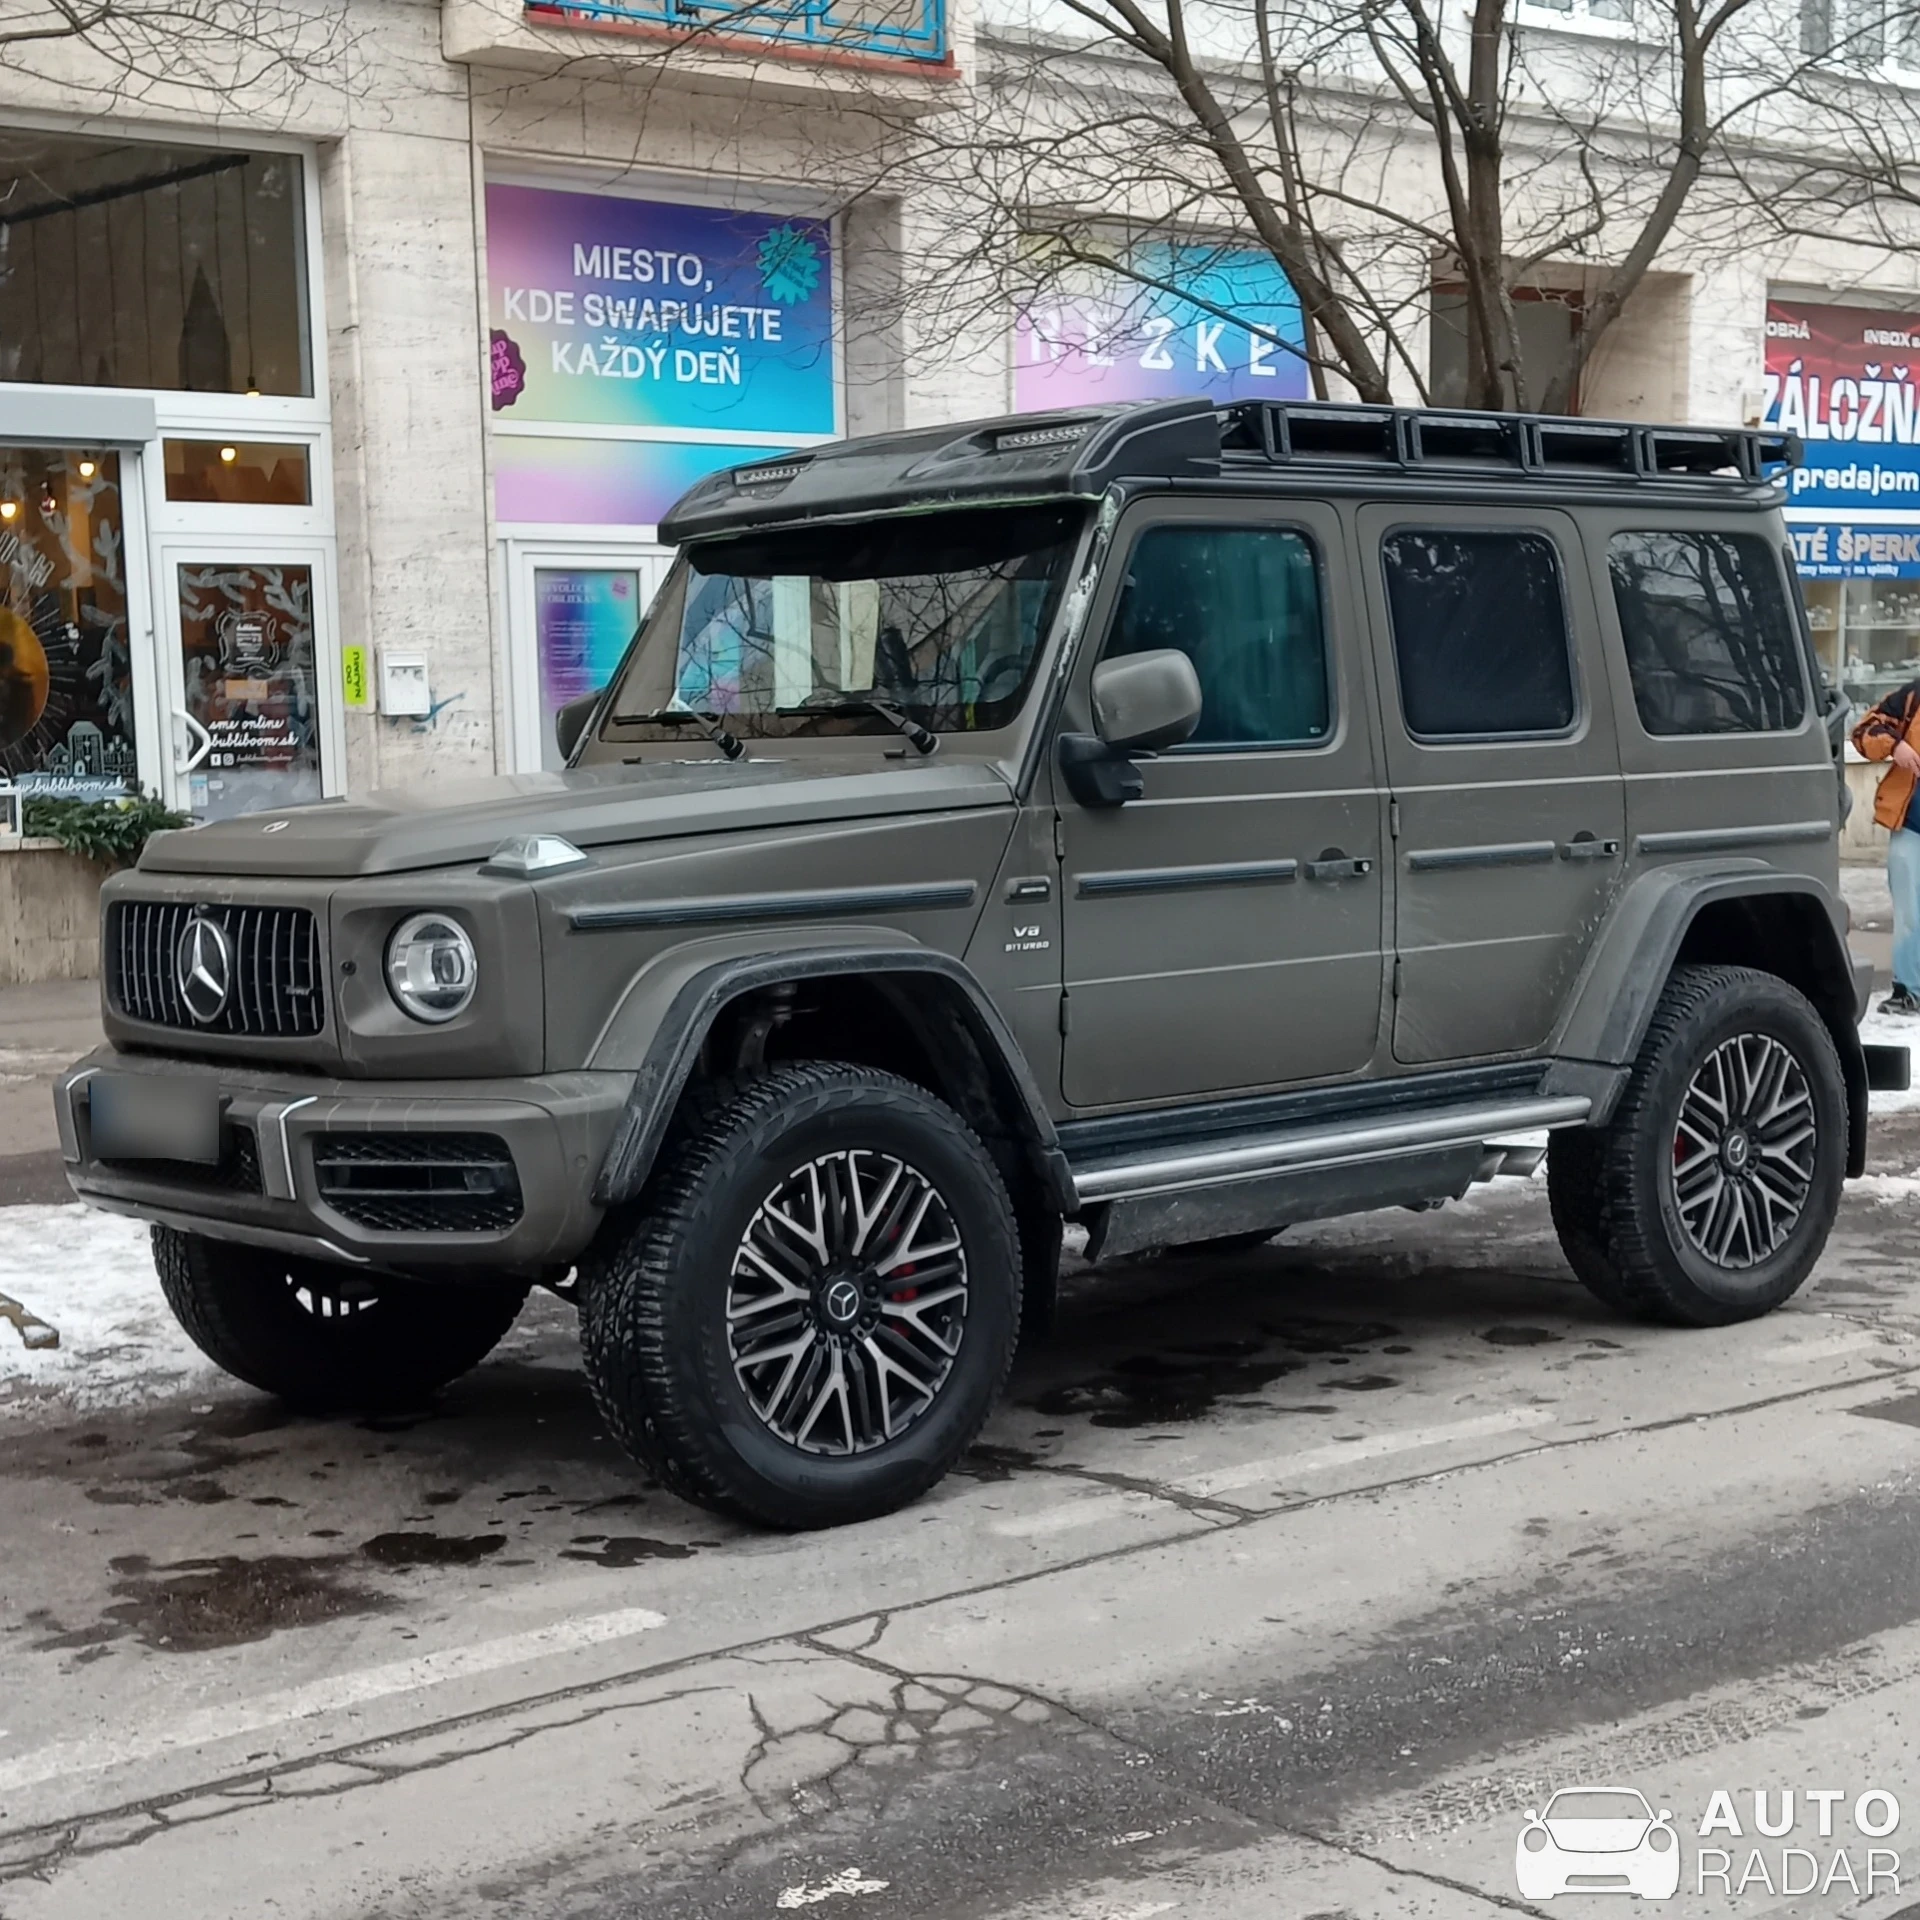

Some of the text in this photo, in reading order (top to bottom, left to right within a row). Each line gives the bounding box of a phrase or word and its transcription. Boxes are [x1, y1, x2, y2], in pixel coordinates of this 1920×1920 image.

[573, 243, 713, 293] MIESTO,
[503, 287, 783, 342] KDE SWAPUJETE
[1863, 329, 1911, 348] INBOX
[552, 335, 740, 385] KAŽDÝ DEŇ
[1763, 359, 1920, 444] ZÁLOŽŇ
[1793, 463, 1919, 496] predajom
[345, 664, 353, 685] DO
[208, 714, 285, 731] sme online
[1013, 925, 1040, 938] V8
